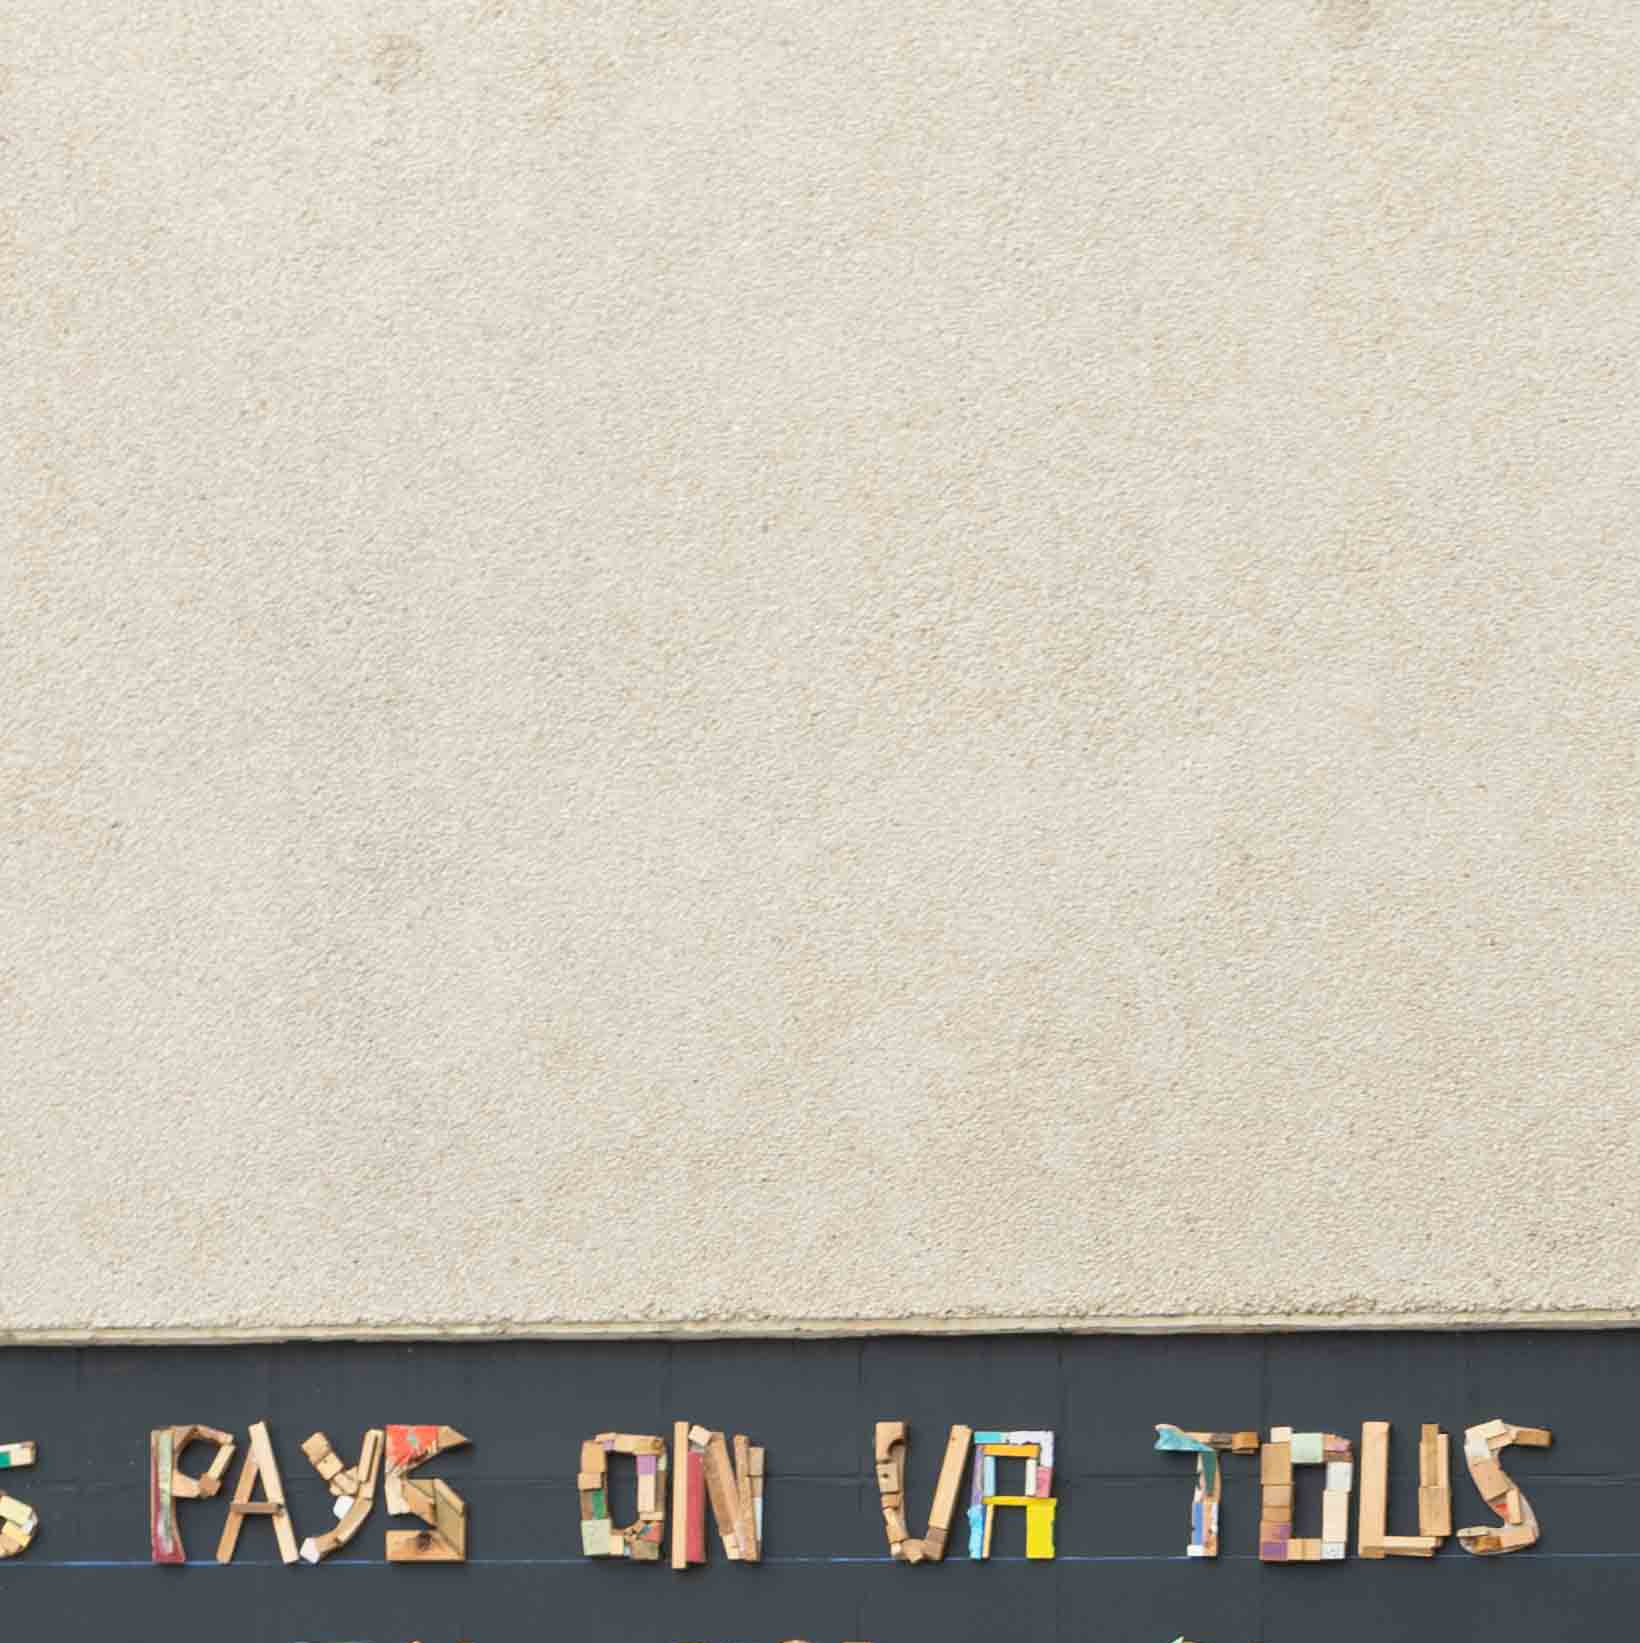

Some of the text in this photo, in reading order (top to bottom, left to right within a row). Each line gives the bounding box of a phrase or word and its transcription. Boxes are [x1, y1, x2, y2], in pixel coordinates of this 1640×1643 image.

[151, 1421, 474, 1564] PAYS
[579, 1421, 764, 1569] ON
[874, 1420, 1057, 1563] VA
[1154, 1418, 1553, 1561] TOUS
